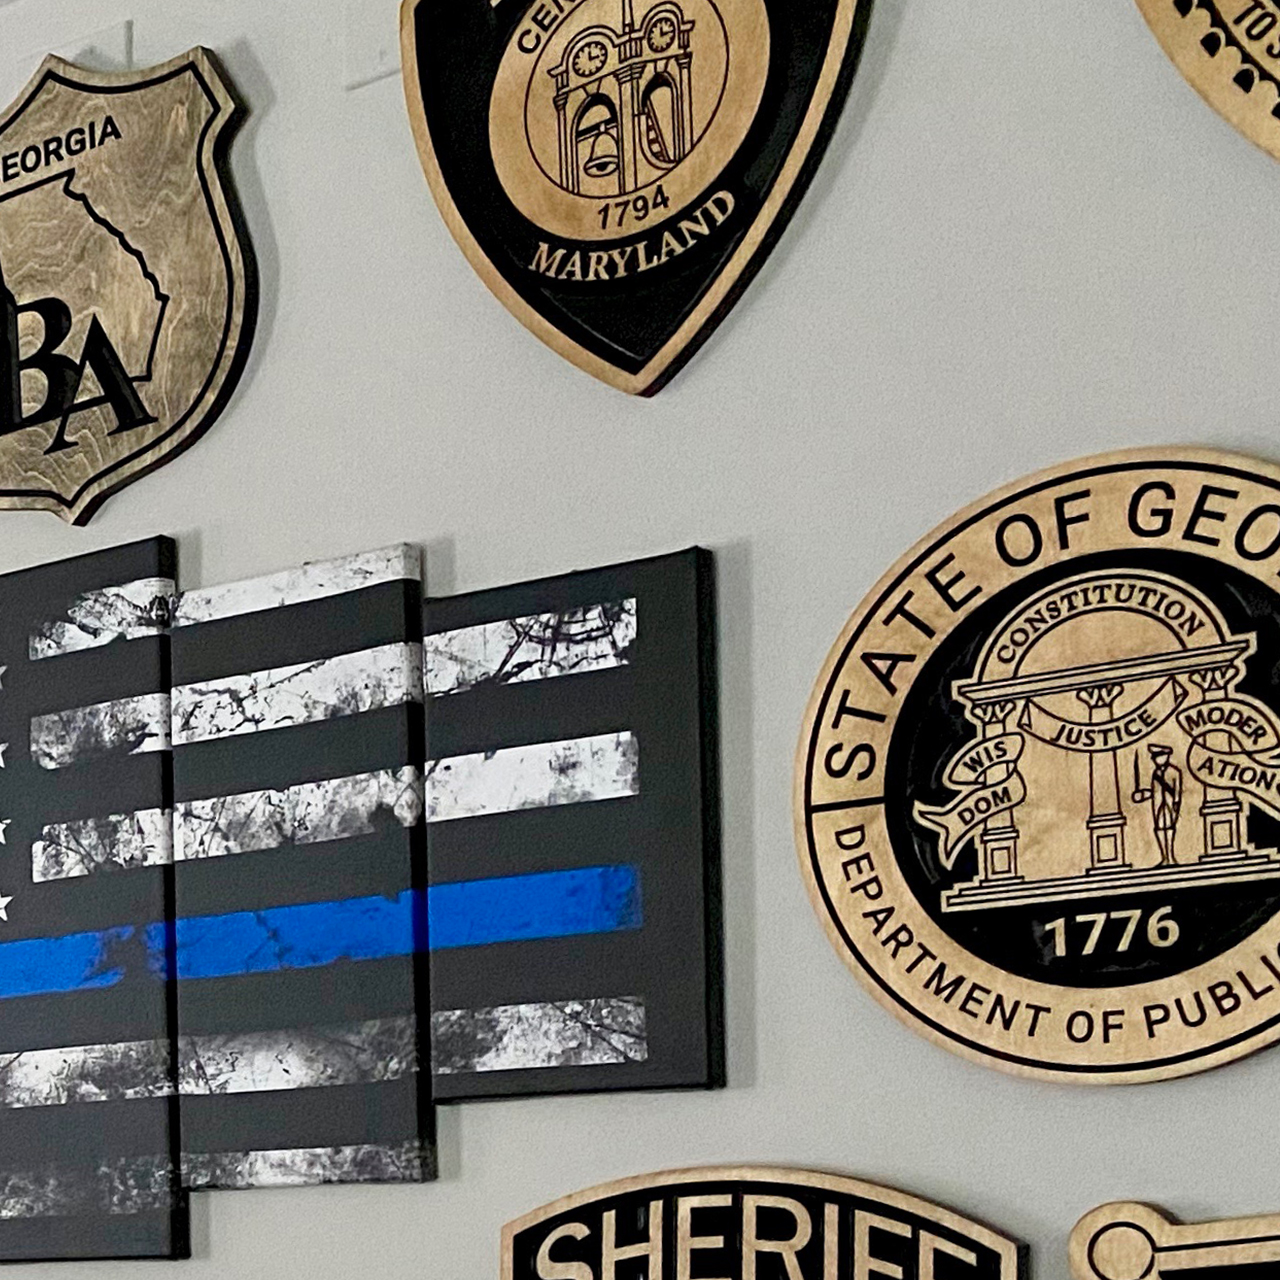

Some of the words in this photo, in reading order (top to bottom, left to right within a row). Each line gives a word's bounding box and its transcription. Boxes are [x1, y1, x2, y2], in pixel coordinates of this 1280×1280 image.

[597, 184, 670, 231] 1794
[528, 189, 737, 282] MARYLAND
[824, 552, 983, 781] STATE
[994, 489, 1093, 568] OF
[1127, 480, 1280, 577] GEO
[996, 583, 1206, 665] CONSTITUTION
[1049, 711, 1158, 746] JUSTICE
[1185, 707, 1268, 745] MODER
[962, 741, 1008, 773] WIS
[956, 786, 1012, 826] DOM
[834, 824, 1051, 1039] DEPARTMENT
[1066, 1009, 1125, 1044] OF
[1143, 940, 1280, 1038] PUBLI
[1044, 906, 1180, 957] 1776
